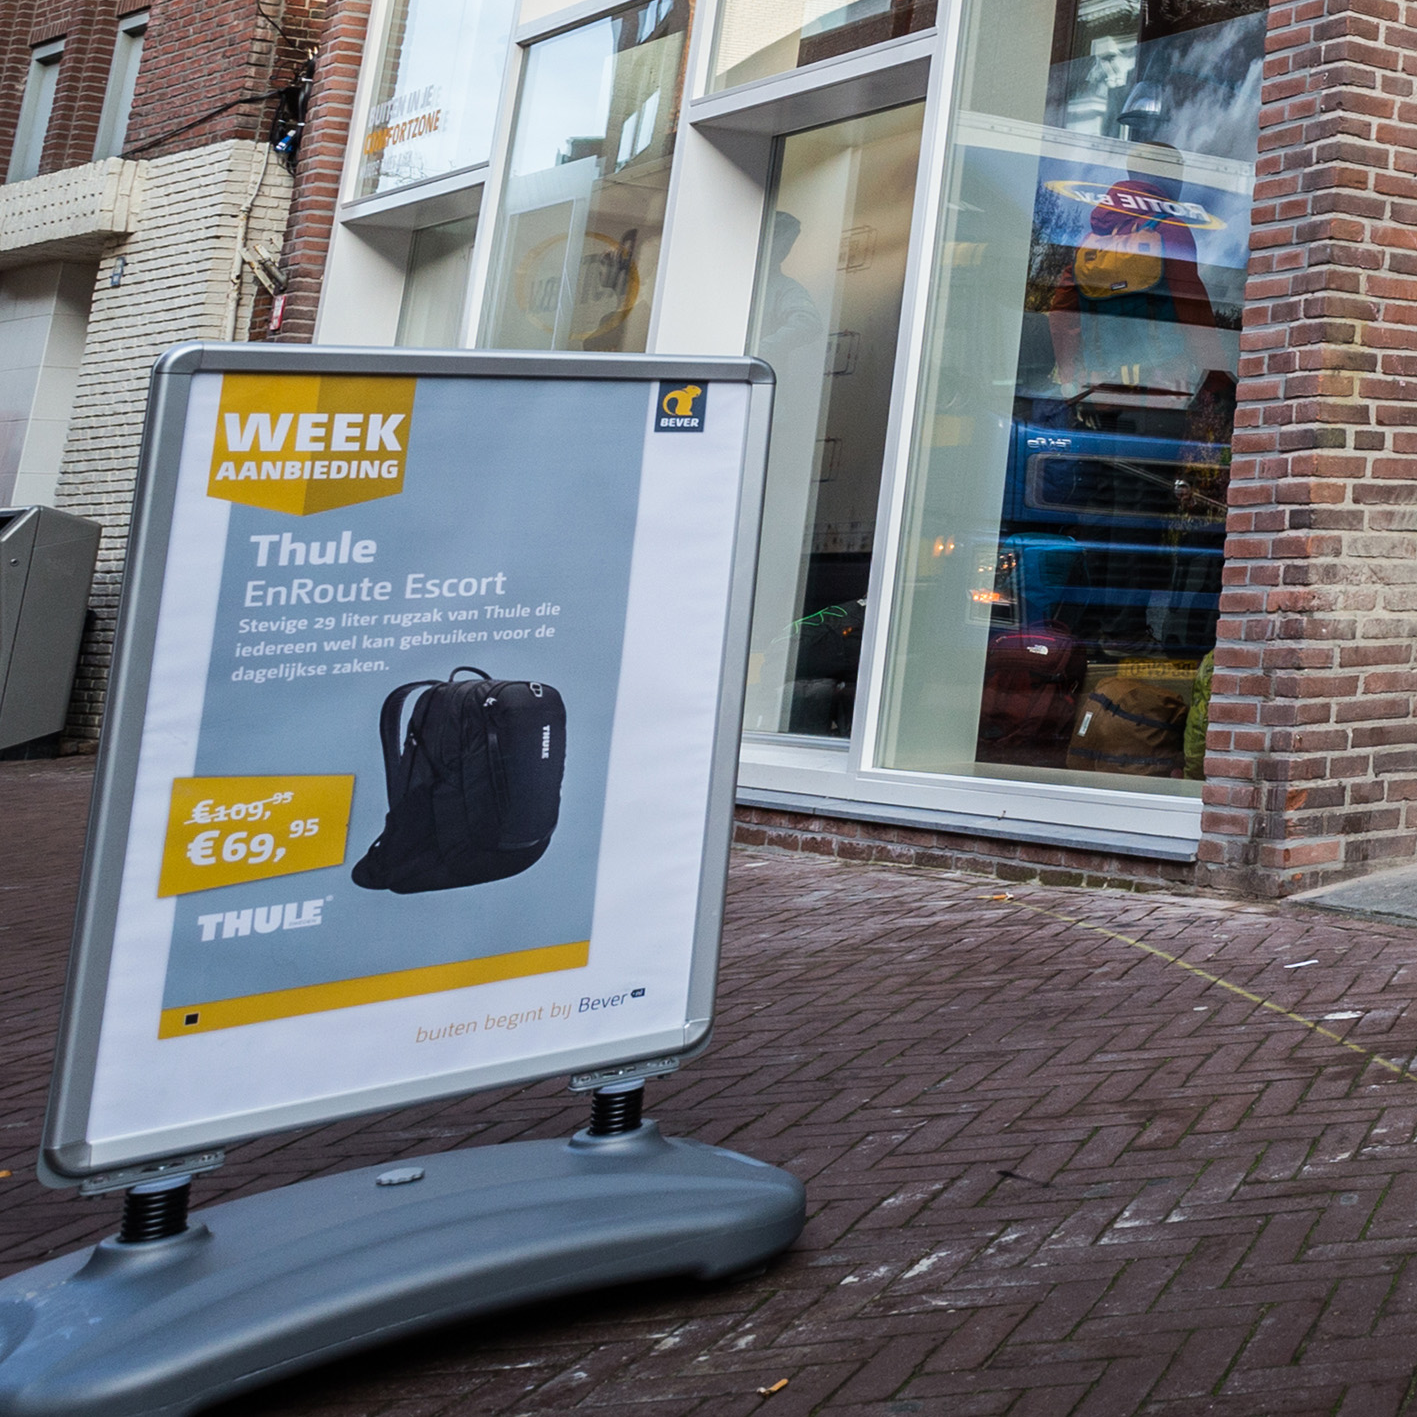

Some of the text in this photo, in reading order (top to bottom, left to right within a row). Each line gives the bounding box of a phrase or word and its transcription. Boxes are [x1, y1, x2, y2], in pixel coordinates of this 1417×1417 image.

[224, 413, 406, 452] WEEK
[659, 417, 700, 428] BEVER
[214, 459, 399, 481] AANBIEDING
[249, 530, 377, 567] Thule
[244, 571, 508, 608] EnRoute Escort
[238, 602, 561, 635] Stevige 29 liter rugzak van Thule die
[235, 624, 556, 658] iedereen wel kan gebruiken voor de
[231, 658, 390, 683] dagelijkse zaken.
[541, 725, 551, 760] THULE
[415, 1019, 478, 1044] buiten
[484, 1006, 545, 1031] begint
[578, 992, 628, 1014] Bever
